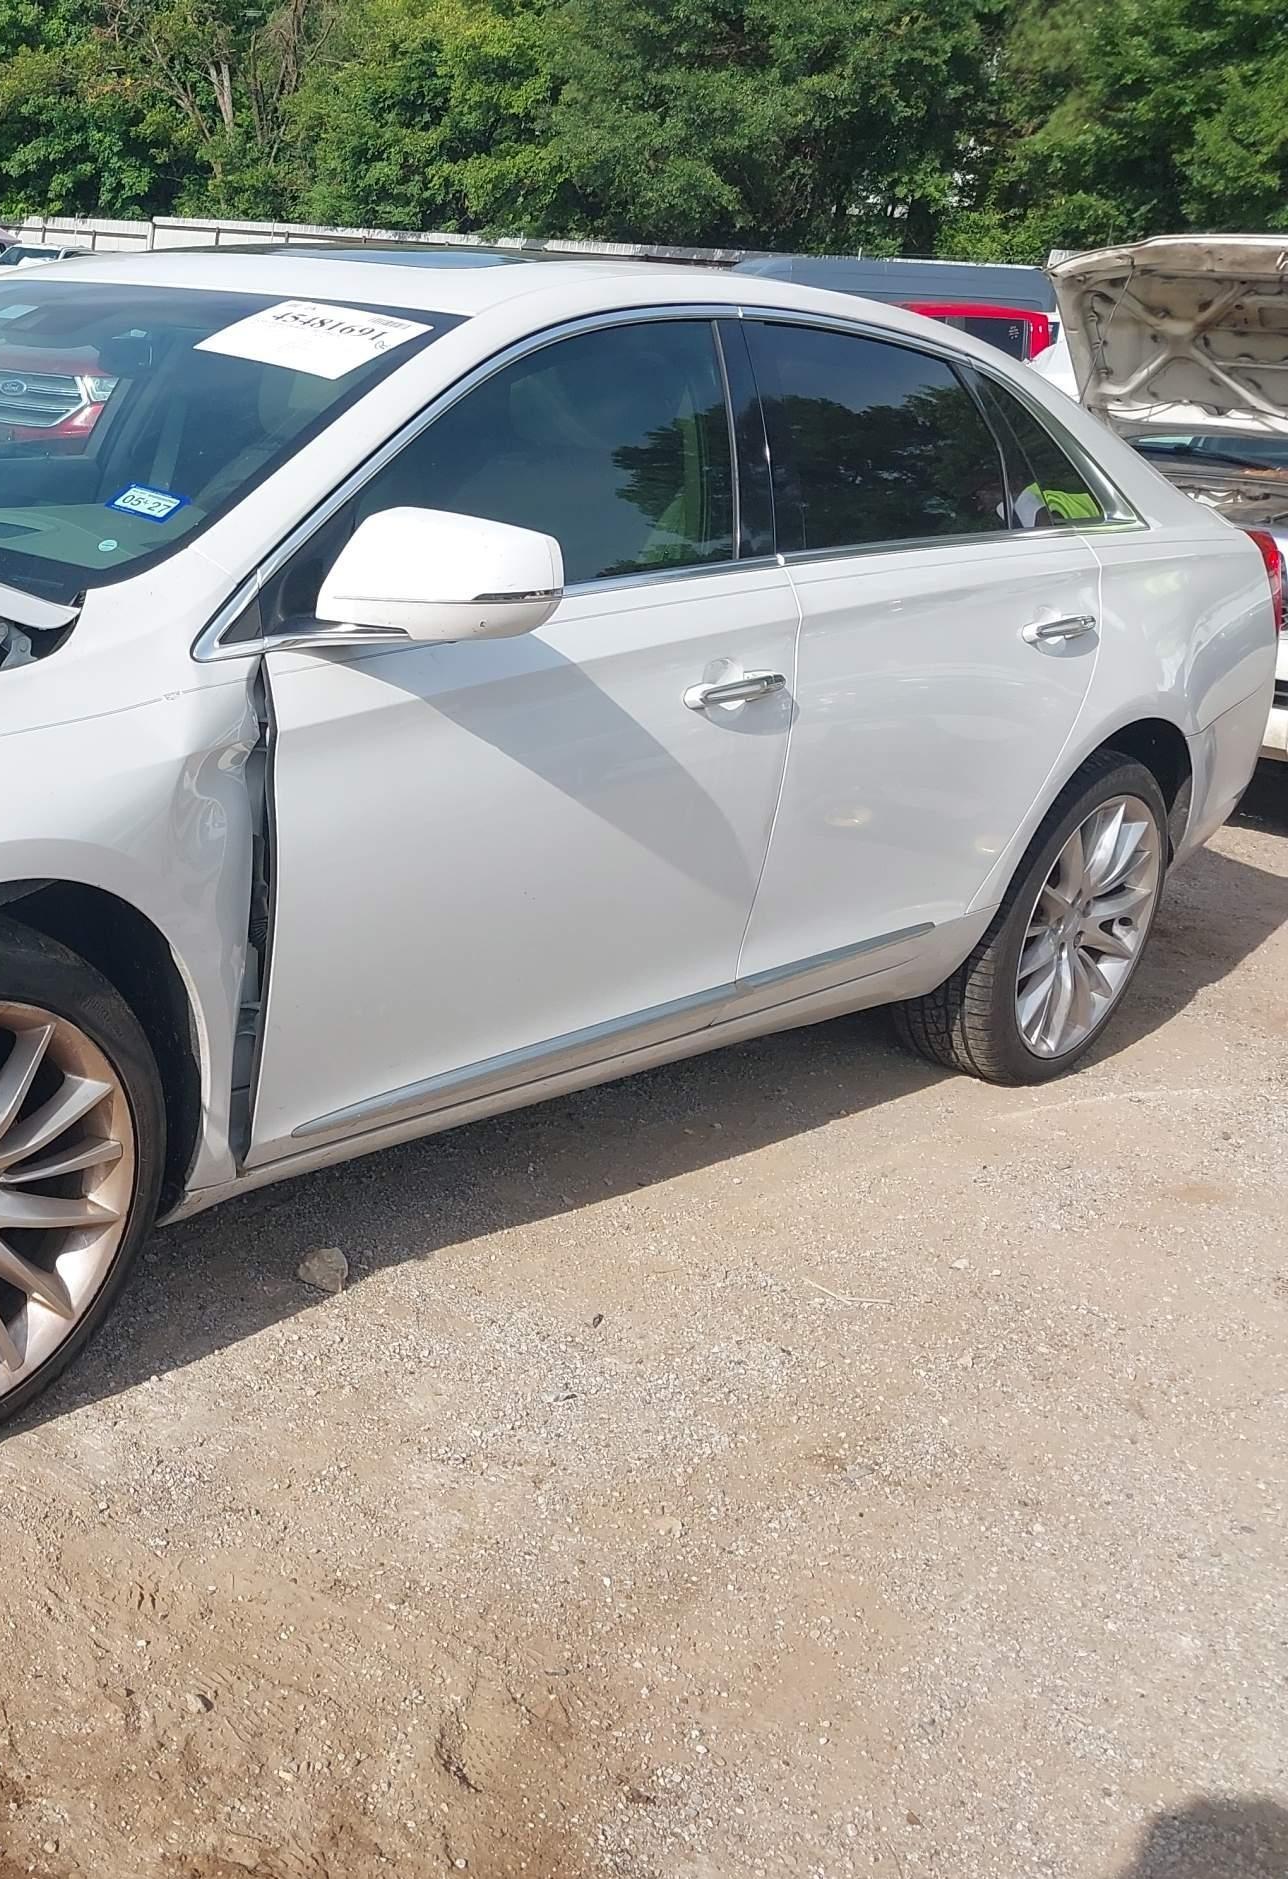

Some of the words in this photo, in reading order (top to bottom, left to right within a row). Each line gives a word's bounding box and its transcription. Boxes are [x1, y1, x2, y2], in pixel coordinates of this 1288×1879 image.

[272, 312, 387, 341] 45481691
[122, 494, 144, 506] 05
[147, 501, 172, 513] 27
